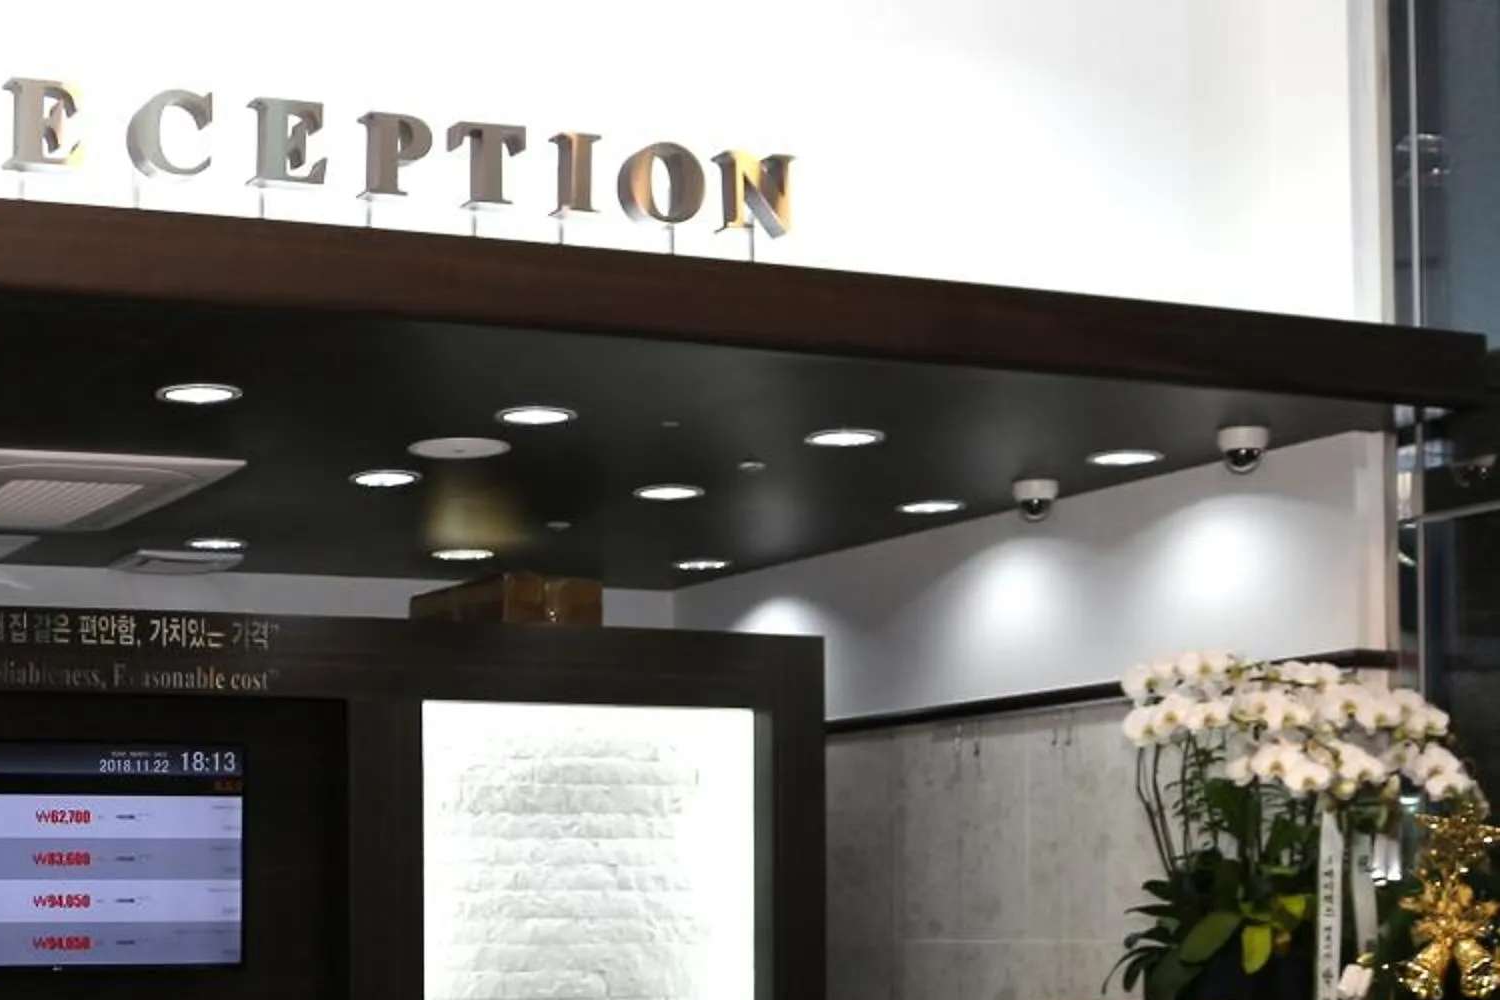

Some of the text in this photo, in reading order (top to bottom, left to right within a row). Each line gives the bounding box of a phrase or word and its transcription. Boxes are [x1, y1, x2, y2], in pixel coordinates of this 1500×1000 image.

[79, 615, 141, 648] 편안함,
[150, 617, 226, 648] 가치있는
[113, 663, 225, 690] Rasonable
[100, 752, 235, 773] 2018.11.22 18:13
